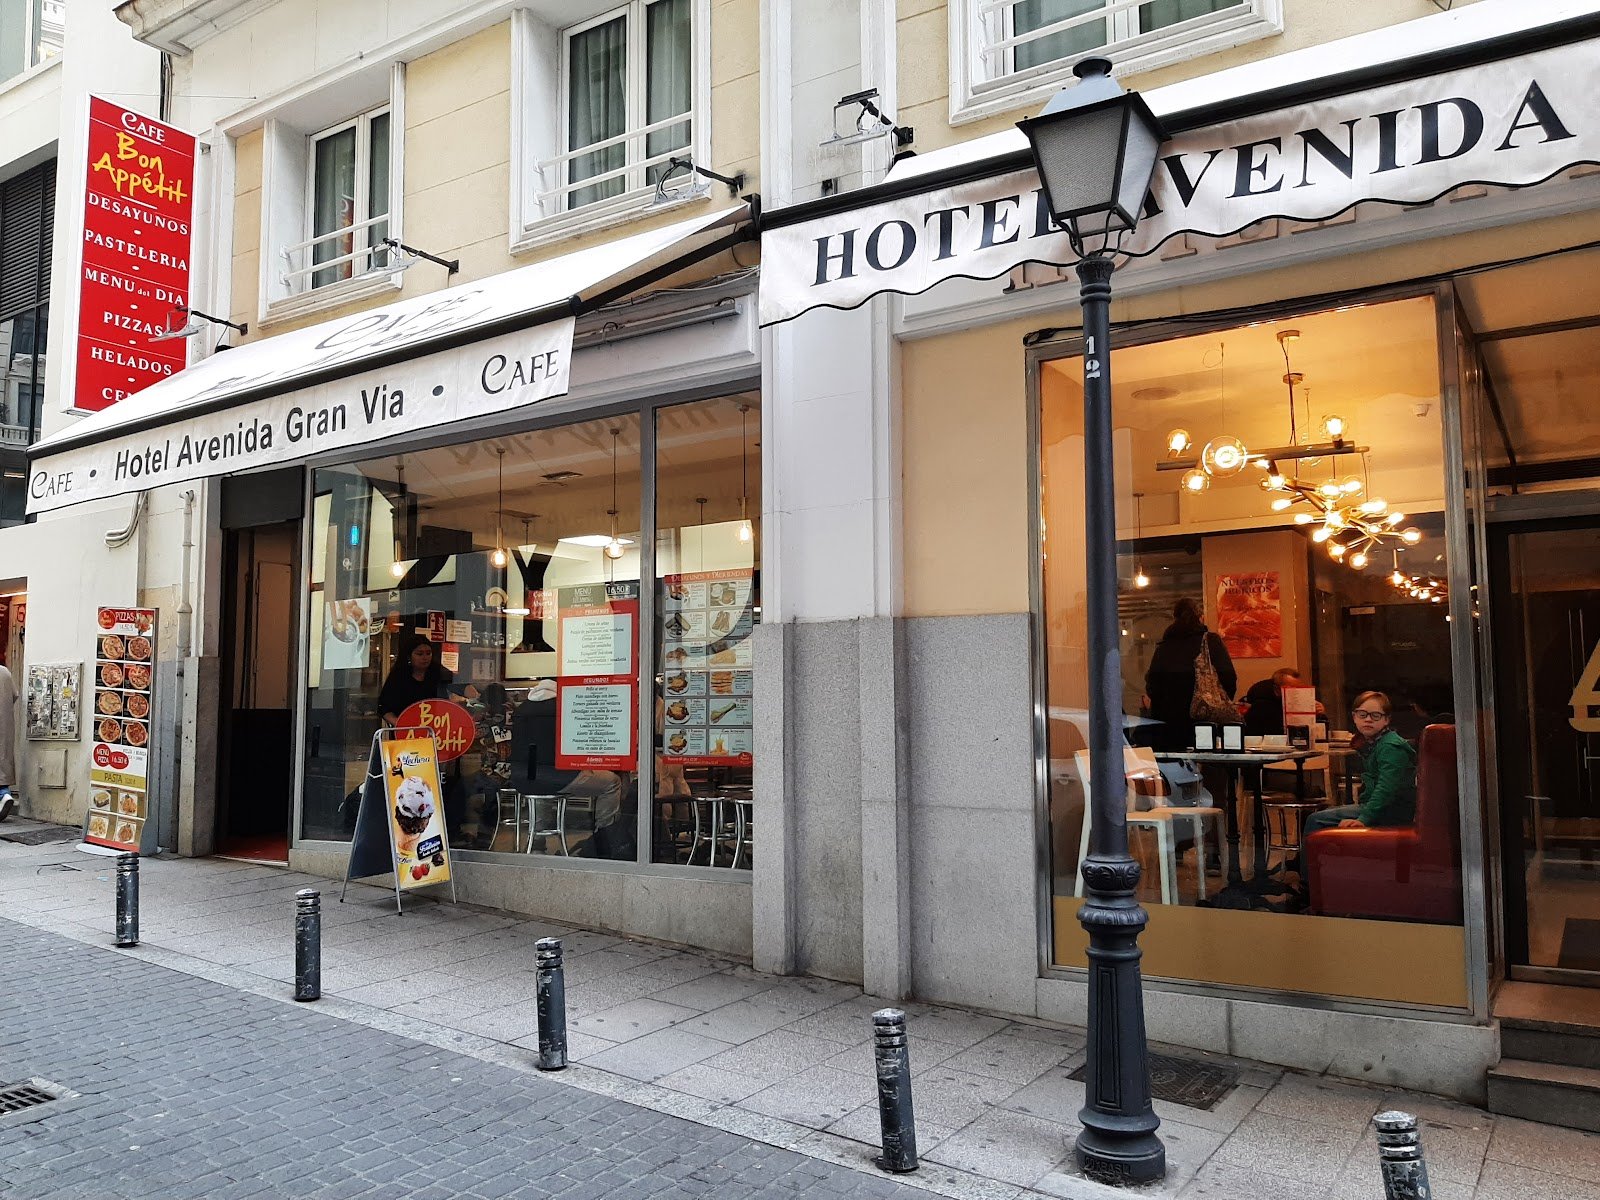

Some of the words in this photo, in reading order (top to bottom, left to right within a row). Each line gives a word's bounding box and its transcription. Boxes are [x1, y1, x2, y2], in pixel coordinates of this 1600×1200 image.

[121, 112, 165, 142] CAFE
[116, 132, 163, 174] Bon
[1141, 79, 1577, 221] VENIDA
[91, 152, 188, 204] Appétit
[88, 192, 189, 236] DESAYUNOS
[85, 229, 188, 272] PASTELERIA
[85, 268, 136, 292] MENU
[156, 288, 185, 306] DIA
[103, 311, 163, 337] PIZZAS
[91, 347, 173, 376] HELADOS
[31, 471, 74, 499] CAFE
[115, 440, 170, 481] Hotel
[177, 418, 273, 467] Avenida
[286, 403, 346, 442] Gran
[361, 384, 404, 424] Via
[481, 349, 560, 395] CAFE
[419, 702, 451, 727] Bon
[104, 773, 122, 784] PASTA
